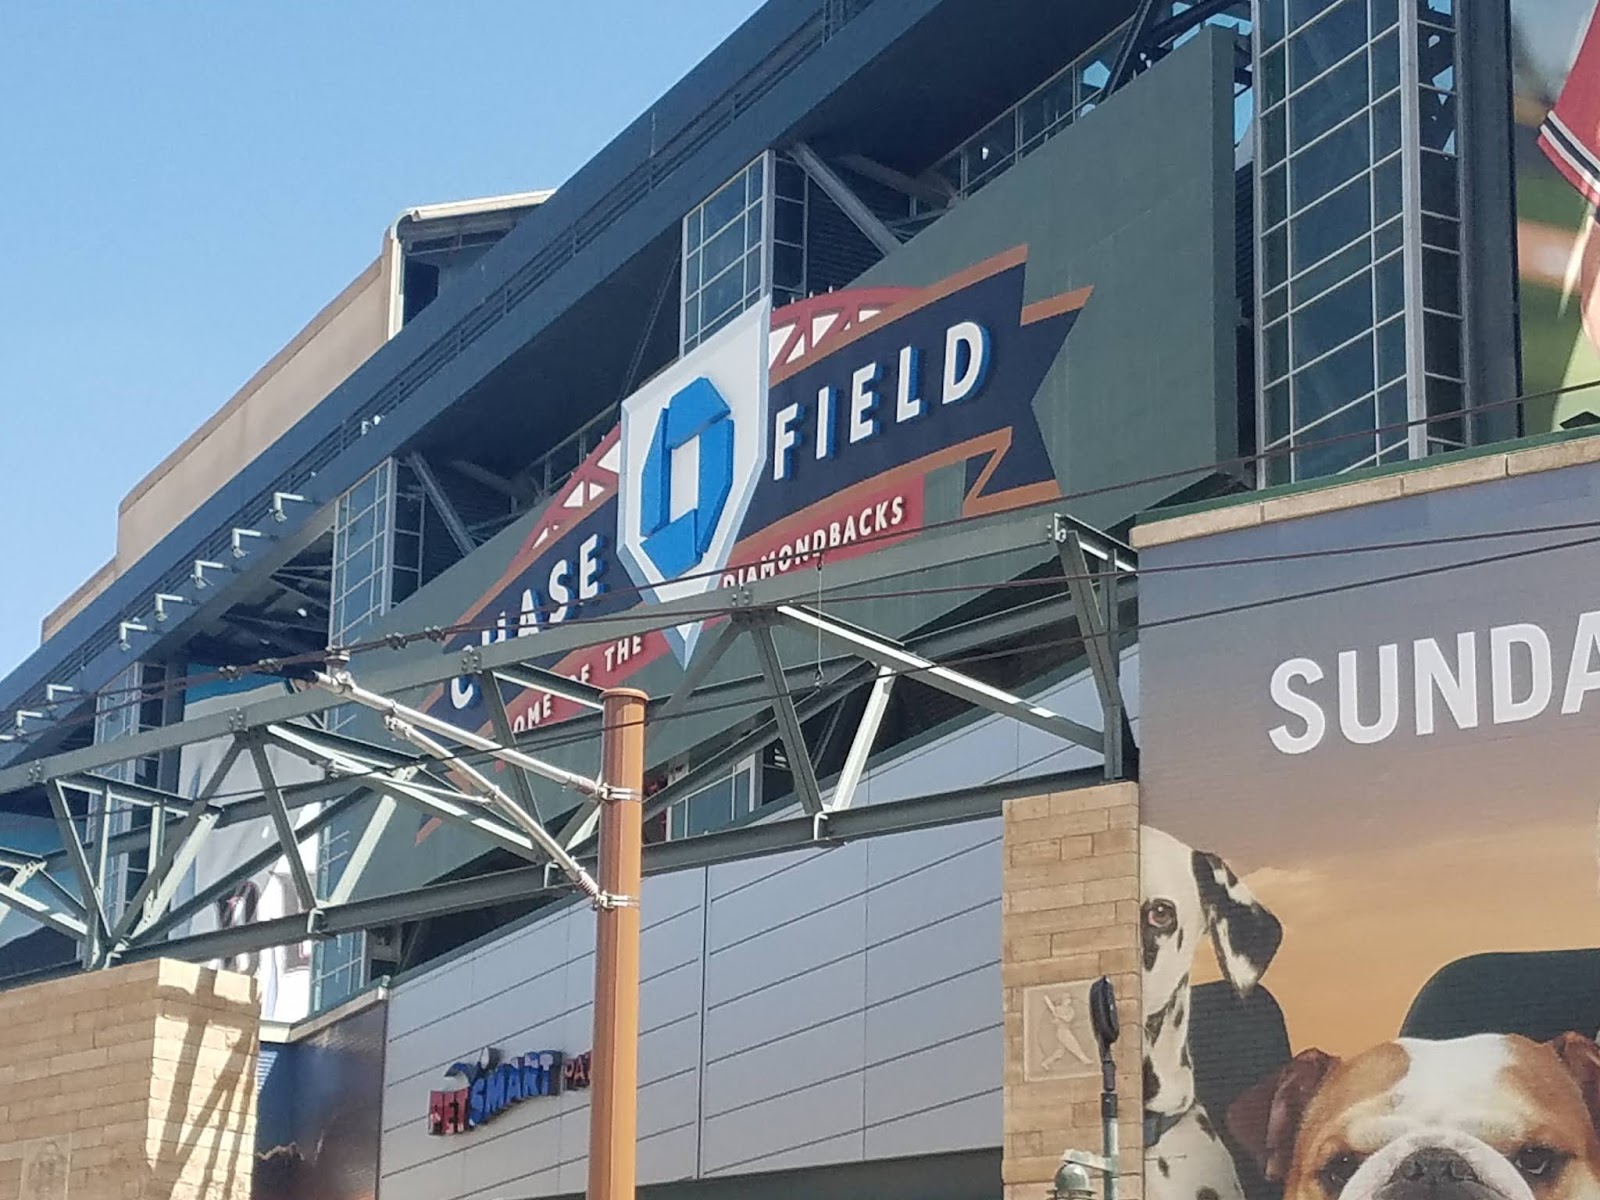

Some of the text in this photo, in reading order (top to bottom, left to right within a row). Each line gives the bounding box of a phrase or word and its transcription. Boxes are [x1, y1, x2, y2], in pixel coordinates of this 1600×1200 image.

[773, 321, 986, 481] FIELD
[512, 693, 552, 733] OME
[604, 635, 642, 672] THE
[723, 496, 904, 589] DIAMONDBACKS
[1268, 609, 1600, 755] SUNDA
